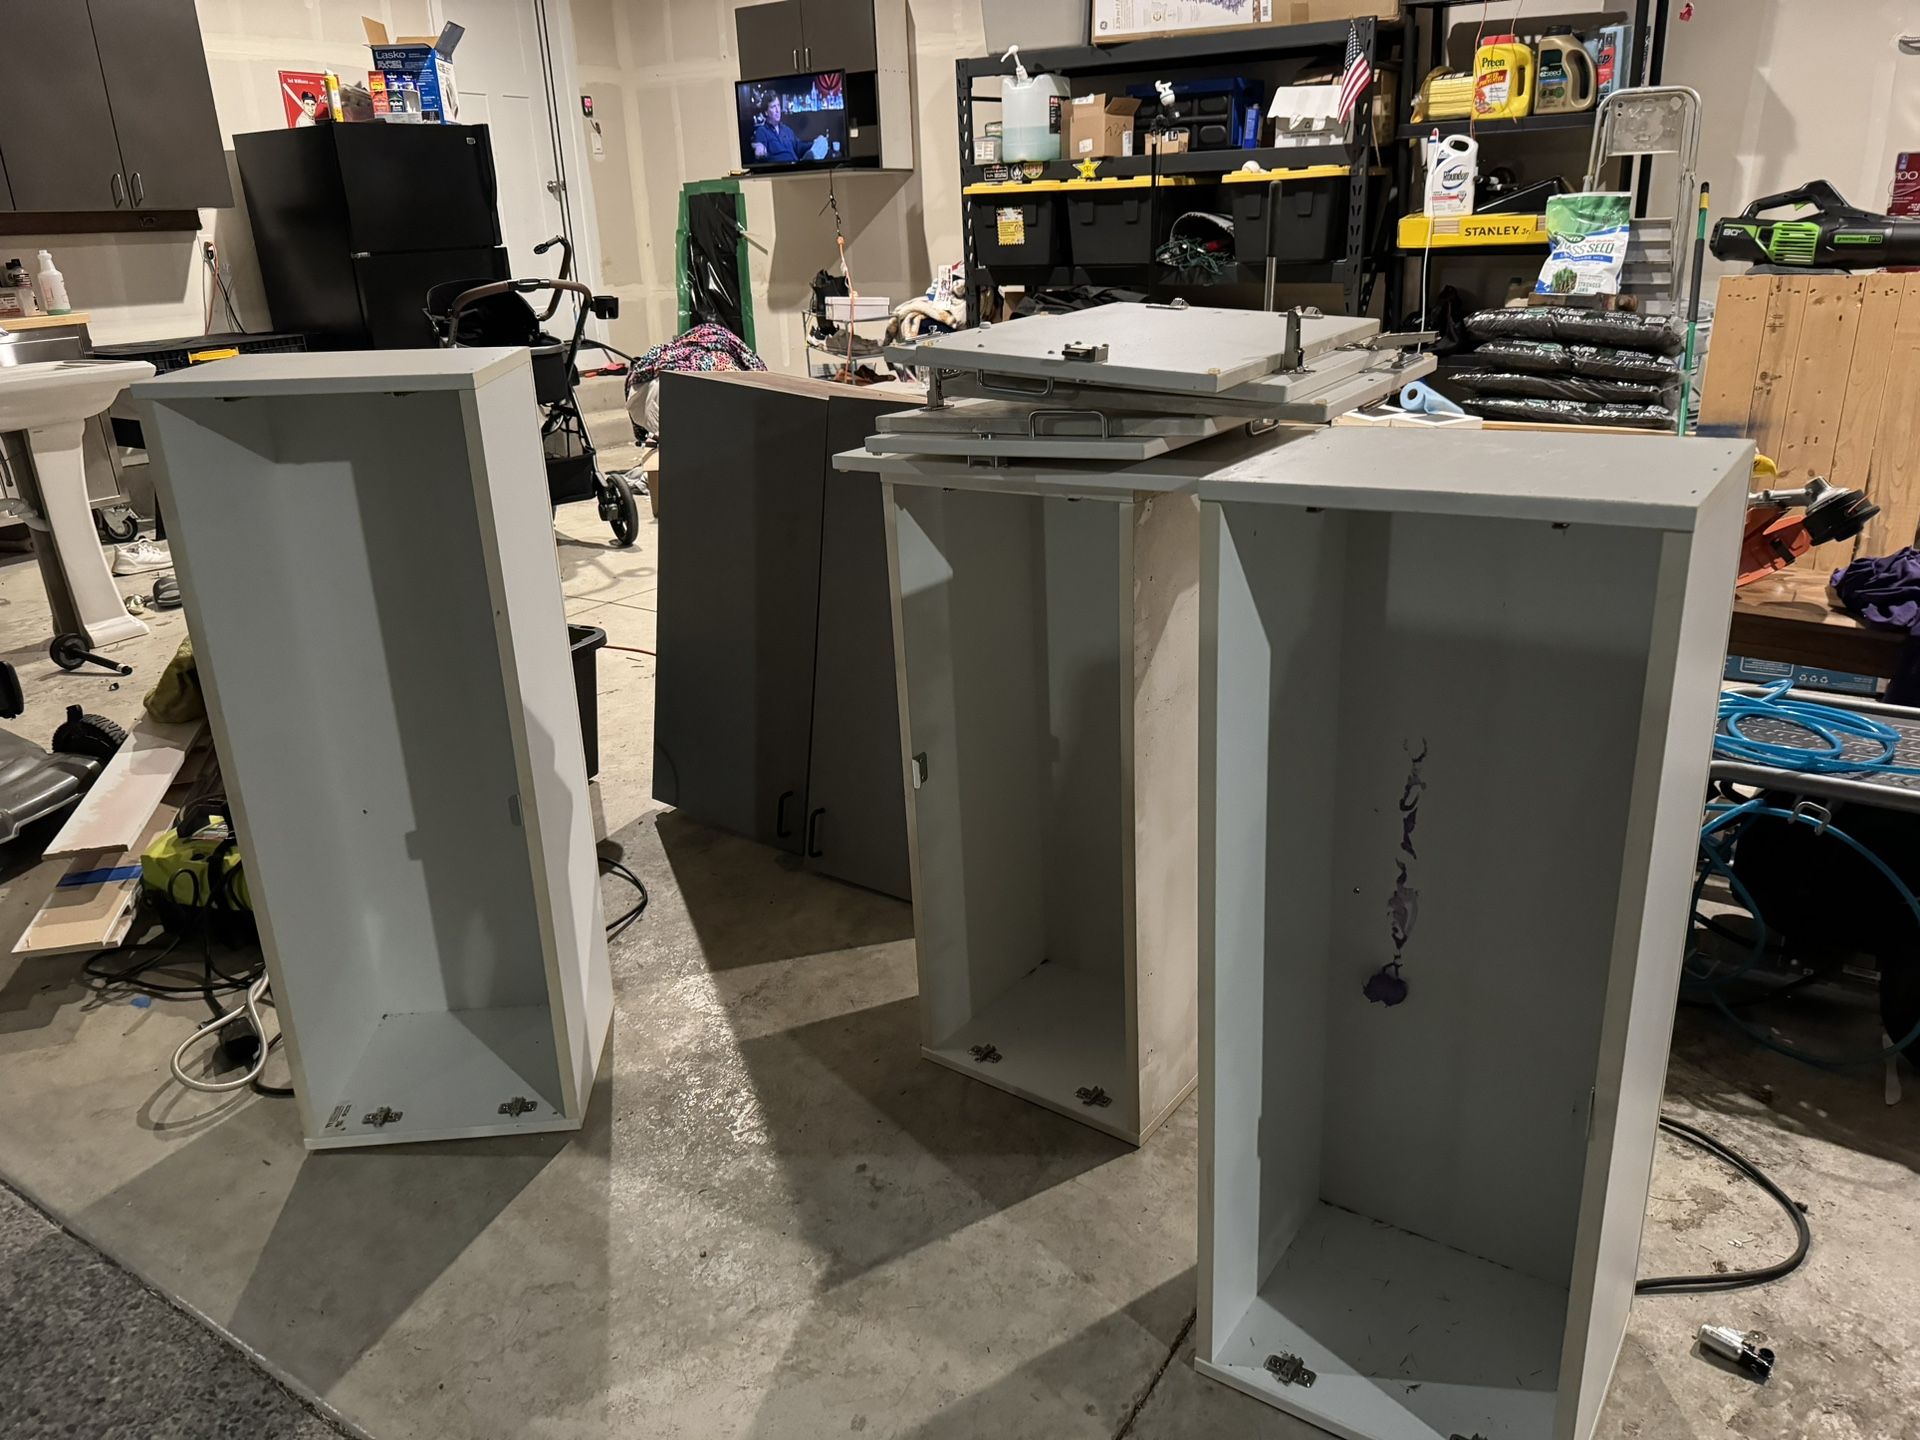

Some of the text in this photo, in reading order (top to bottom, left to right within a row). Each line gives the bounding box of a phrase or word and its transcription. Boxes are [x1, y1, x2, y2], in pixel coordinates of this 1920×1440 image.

[375, 51, 406, 59] Lasko
[1482, 57, 1505, 68] Preen
[1464, 225, 1520, 237] STANLEY
[1587, 243, 1615, 254] SEED
